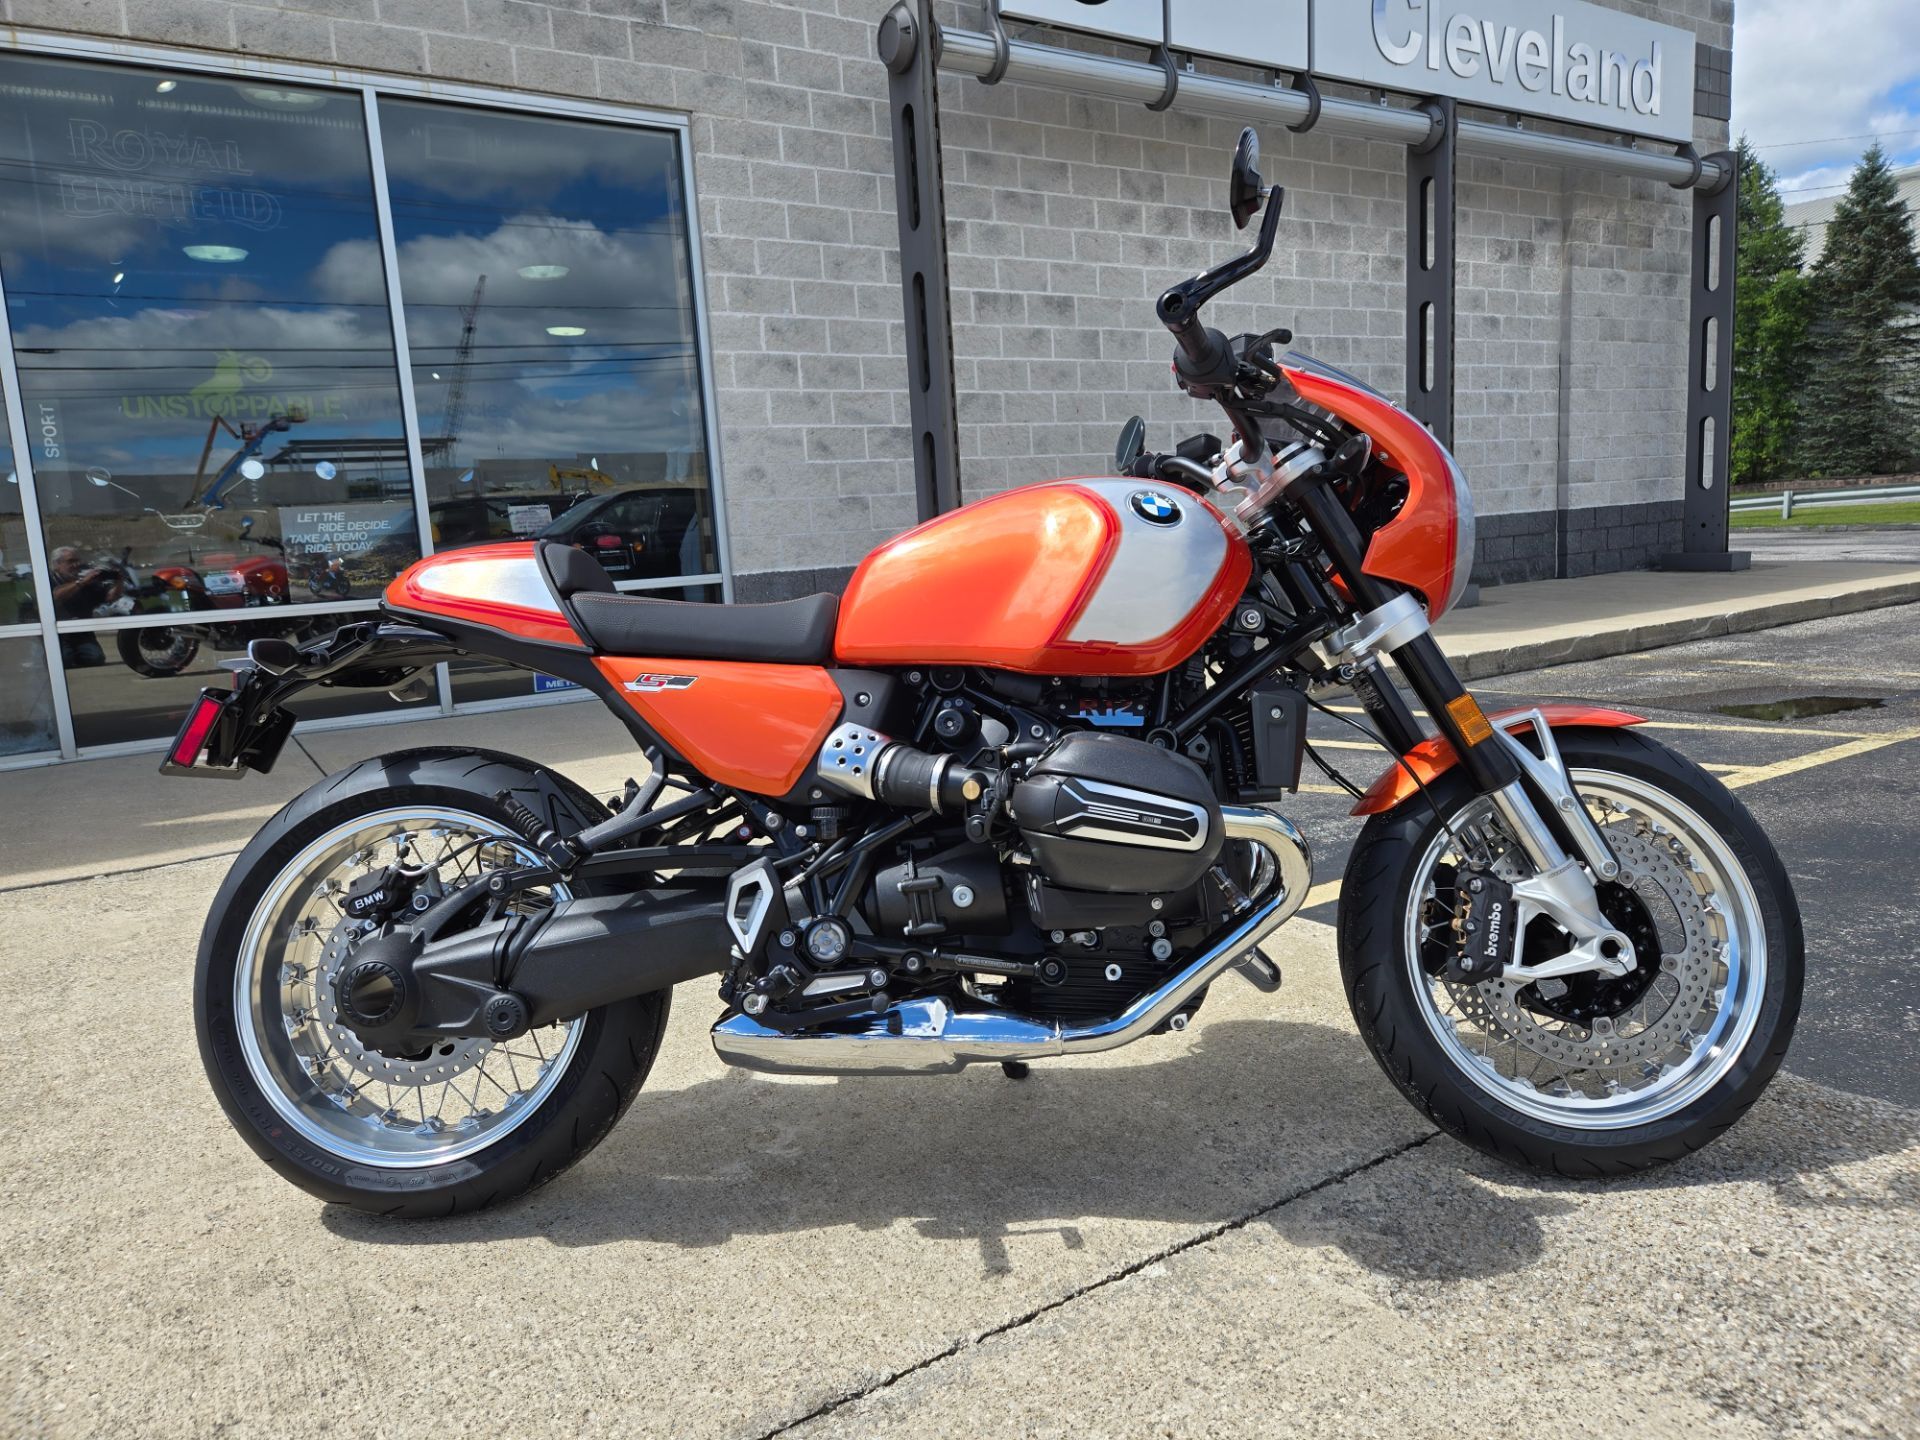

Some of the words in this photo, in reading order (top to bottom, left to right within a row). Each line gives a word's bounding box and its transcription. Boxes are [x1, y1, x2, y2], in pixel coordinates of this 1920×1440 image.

[1372, 0, 1663, 116] Cleveland
[66, 118, 254, 176] ROYAL
[39, 404, 60, 458] SPORT
[297, 513, 320, 523] LET
[322, 512, 345, 521] THE
[318, 522, 345, 532] RIDE
[347, 520, 391, 531] DECIDE.
[289, 534, 319, 544] TAKE
[322, 533, 330, 542] A
[333, 532, 367, 542] DEMO
[305, 543, 332, 553] RIDE
[335, 541, 374, 552] TODAY.
[354, 890, 384, 909] BMW
[1483, 902, 1502, 957] brembo
